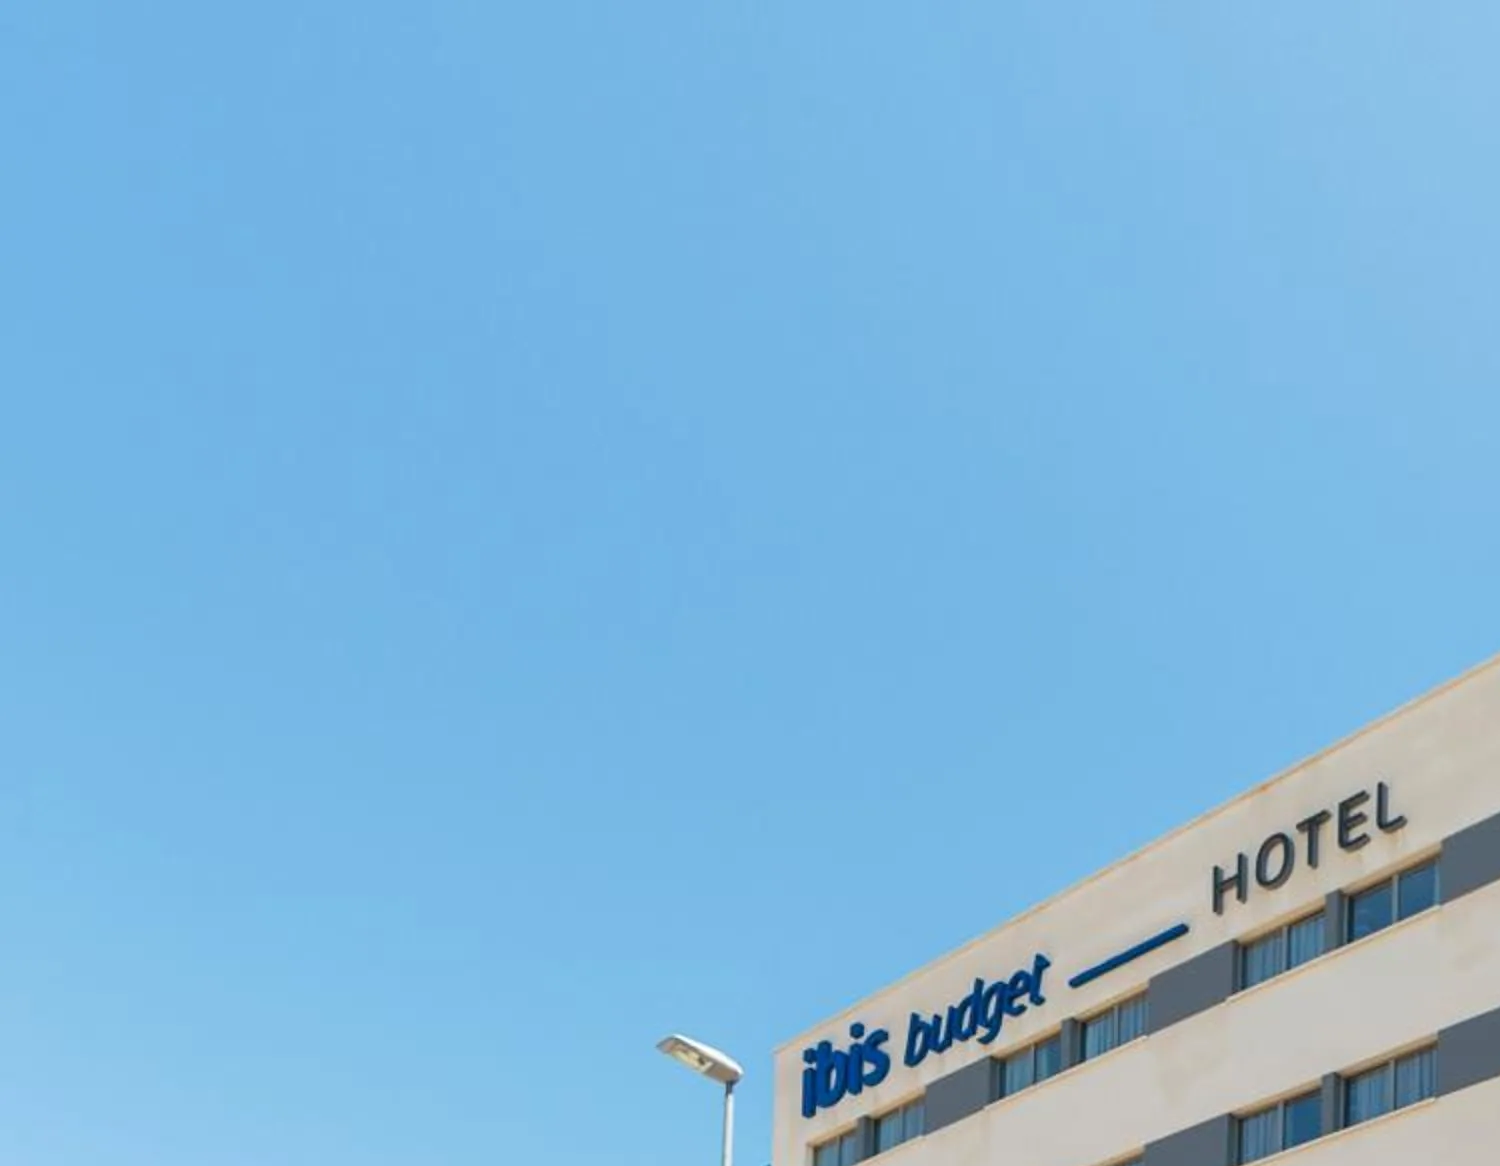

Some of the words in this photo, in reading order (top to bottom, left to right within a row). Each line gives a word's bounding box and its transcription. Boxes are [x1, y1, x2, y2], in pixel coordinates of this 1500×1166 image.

[1212, 781, 1407, 916] HOTEL
[801, 1022, 891, 1119] ibis
[903, 953, 1051, 1068] budget
